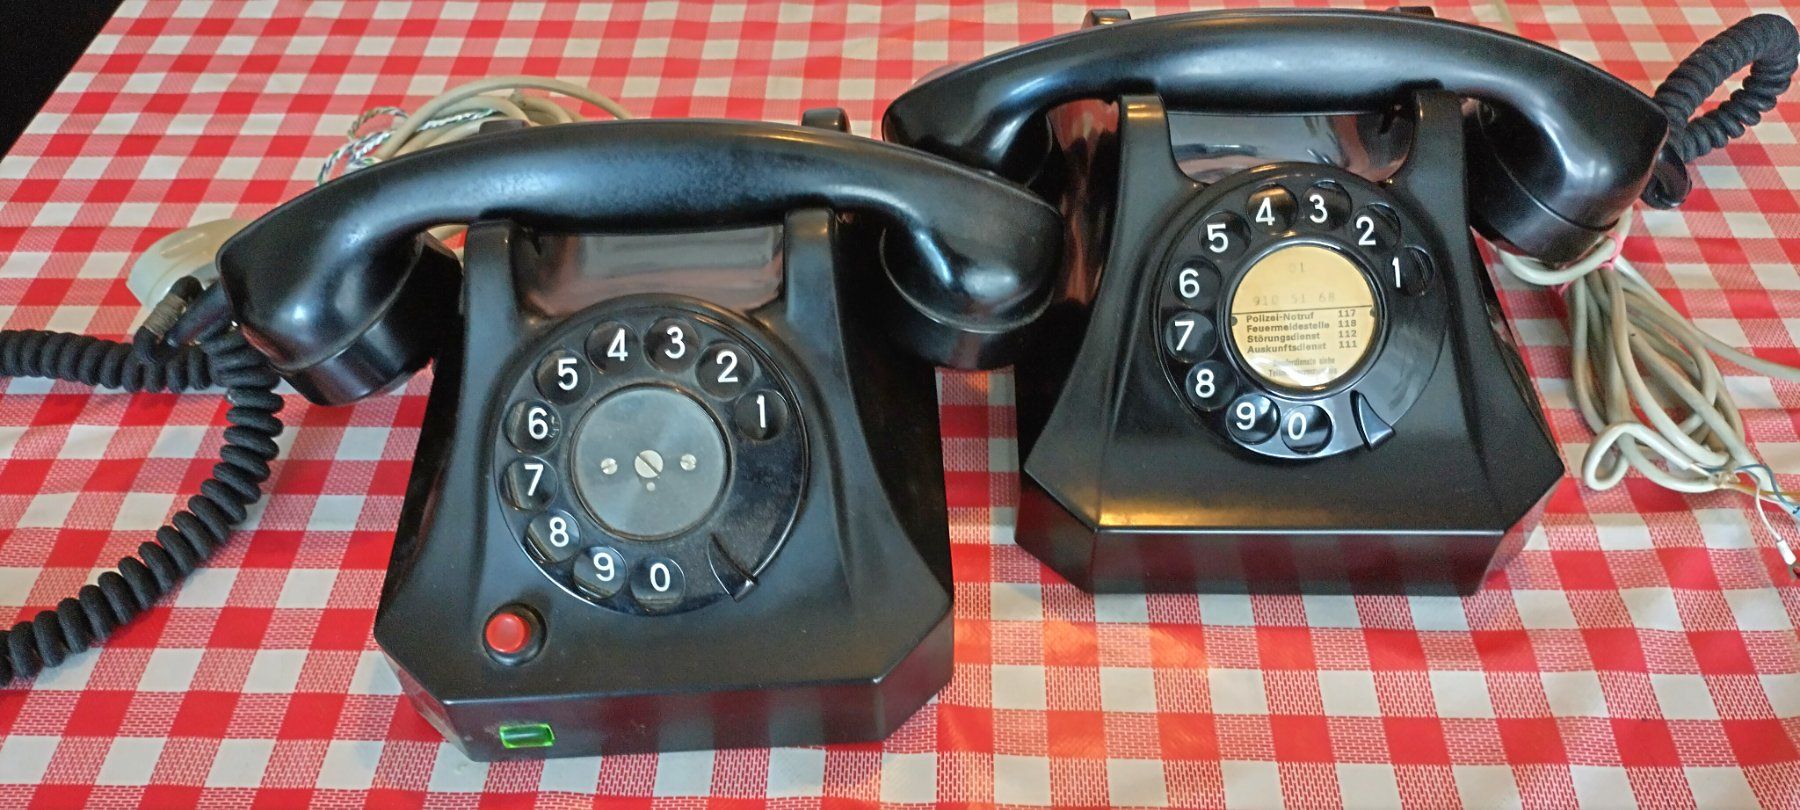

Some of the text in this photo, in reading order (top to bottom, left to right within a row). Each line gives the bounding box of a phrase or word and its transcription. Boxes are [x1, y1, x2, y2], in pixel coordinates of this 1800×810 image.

[1255, 197, 1276, 226] 4
[1309, 194, 1328, 223] 3
[1207, 223, 1229, 253] 5
[1355, 216, 1377, 246] 2
[1179, 268, 1200, 298] 6
[1392, 257, 1401, 288] 1
[1246, 309, 1357, 322] Polizei-Notruf 117
[1247, 319, 1357, 332] Feuermeldestelle 118
[607, 328, 628, 361] 4
[665, 326, 686, 359] 3
[1175, 320, 1195, 351] 7
[1247, 330, 1357, 343] Störungsdienst 112
[1247, 340, 1358, 353] Auskunftsdienst 111
[557, 358, 578, 391] 5
[716, 350, 738, 383] 2
[1195, 369, 1216, 398] 8
[528, 407, 549, 440] 6
[756, 395, 767, 428] 1
[1235, 402, 1256, 431] 9
[1287, 412, 1307, 440] 0
[524, 464, 544, 497] 7
[548, 516, 570, 548] 8
[593, 551, 615, 582] 9
[650, 562, 671, 592] 0
